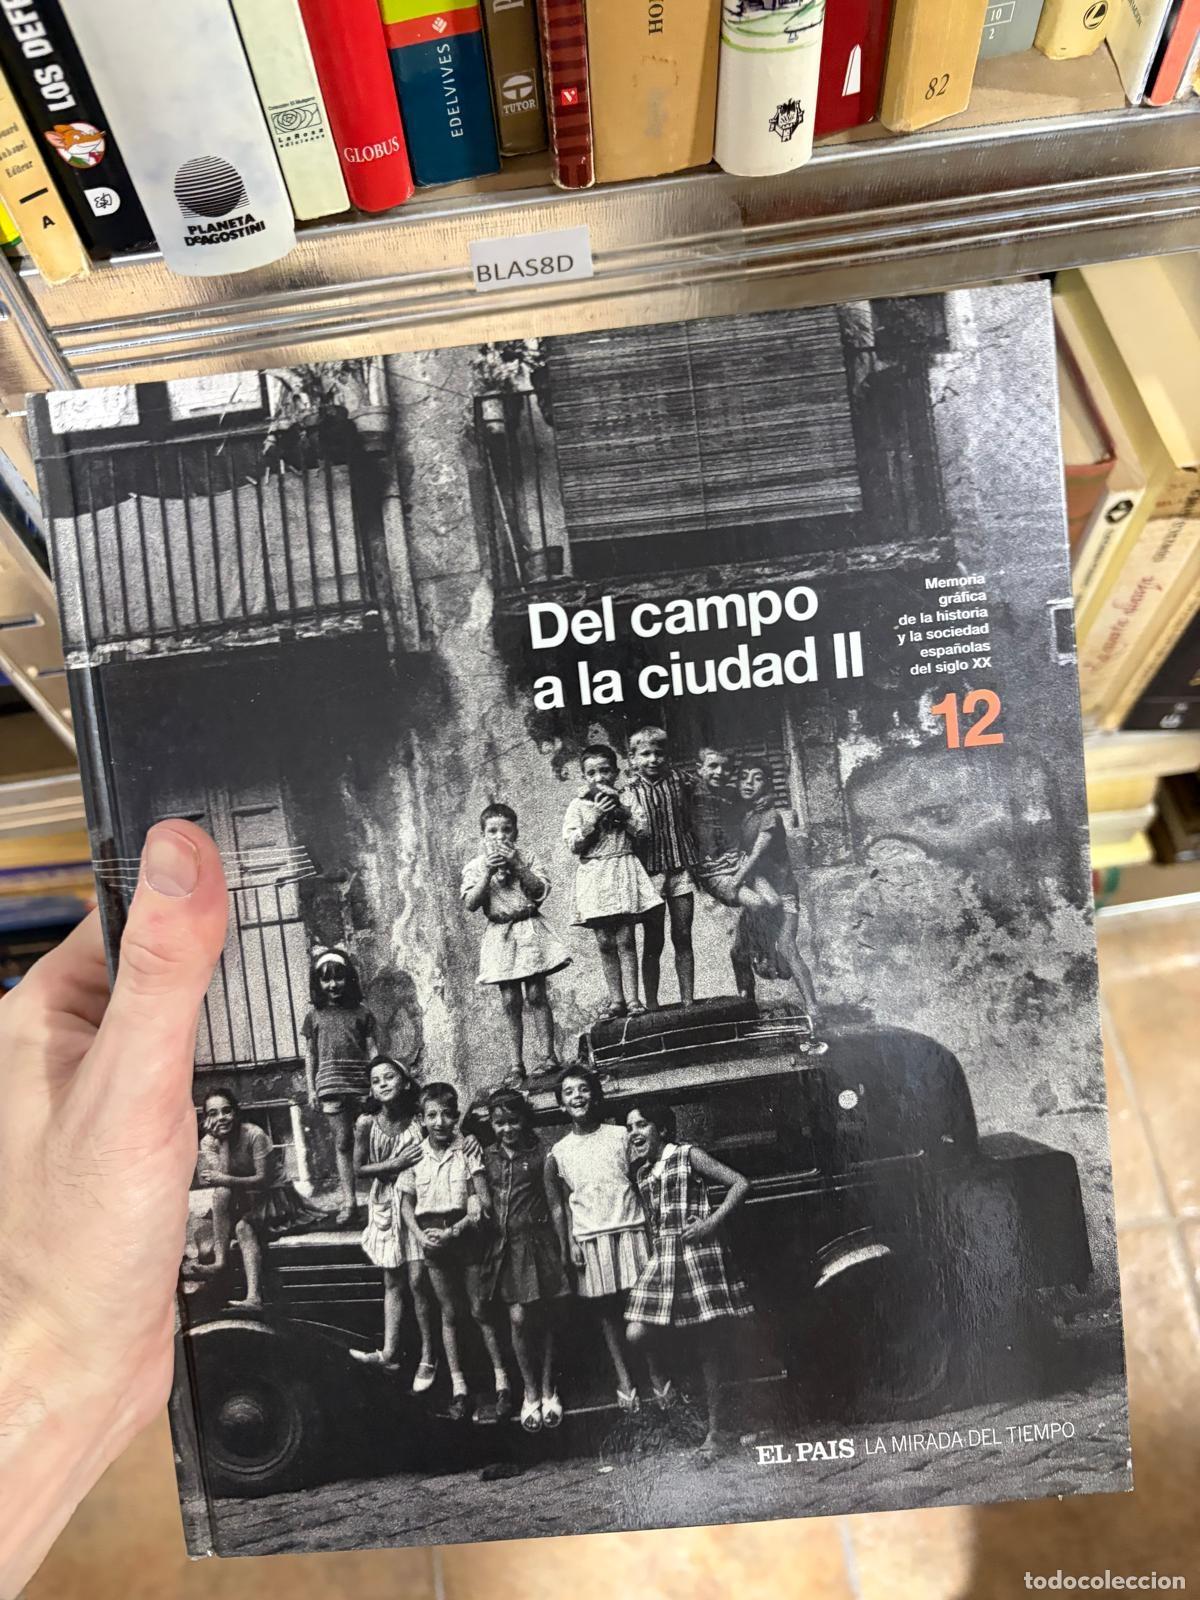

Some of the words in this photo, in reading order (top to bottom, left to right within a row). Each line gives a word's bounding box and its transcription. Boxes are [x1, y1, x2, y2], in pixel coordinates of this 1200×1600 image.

[648, 0, 664, 35] HO
[990, 8, 1002, 21] 10
[989, 28, 995, 40] 2
[33, 64, 77, 112] LOS
[437, 43, 463, 138] EDELVIVES
[925, 73, 951, 101] 82
[503, 98, 537, 114] TUTOR
[343, 136, 401, 163] GLOBUS
[42, 215, 56, 229] A
[187, 213, 256, 235] PLANETA
[476, 254, 575, 283] BLAS8D
[925, 573, 986, 589] Memoria
[938, 591, 987, 607] gráfica
[527, 595, 615, 650] Del
[630, 586, 818, 637] campo
[898, 614, 917, 626] de
[920, 612, 933, 624] la
[936, 607, 989, 622] historia
[896, 634, 906, 646] y
[909, 630, 922, 642] la
[926, 622, 990, 640] sociedad
[920, 641, 991, 658] españolas
[533, 673, 565, 711] a
[577, 659, 624, 706] la
[637, 636, 818, 699] ciudad
[832, 630, 864, 680] II
[910, 663, 932, 676] del
[935, 660, 969, 675] siglo
[972, 656, 993, 669] XX
[930, 689, 1004, 749] 12
[756, 1445, 792, 1465] EL
[795, 1438, 855, 1462] PAIS
[865, 1436, 887, 1455] LA
[891, 1431, 963, 1453] MIRADA
[968, 1428, 1002, 1447] DEL
[1006, 1421, 1075, 1444] TIEMPO
